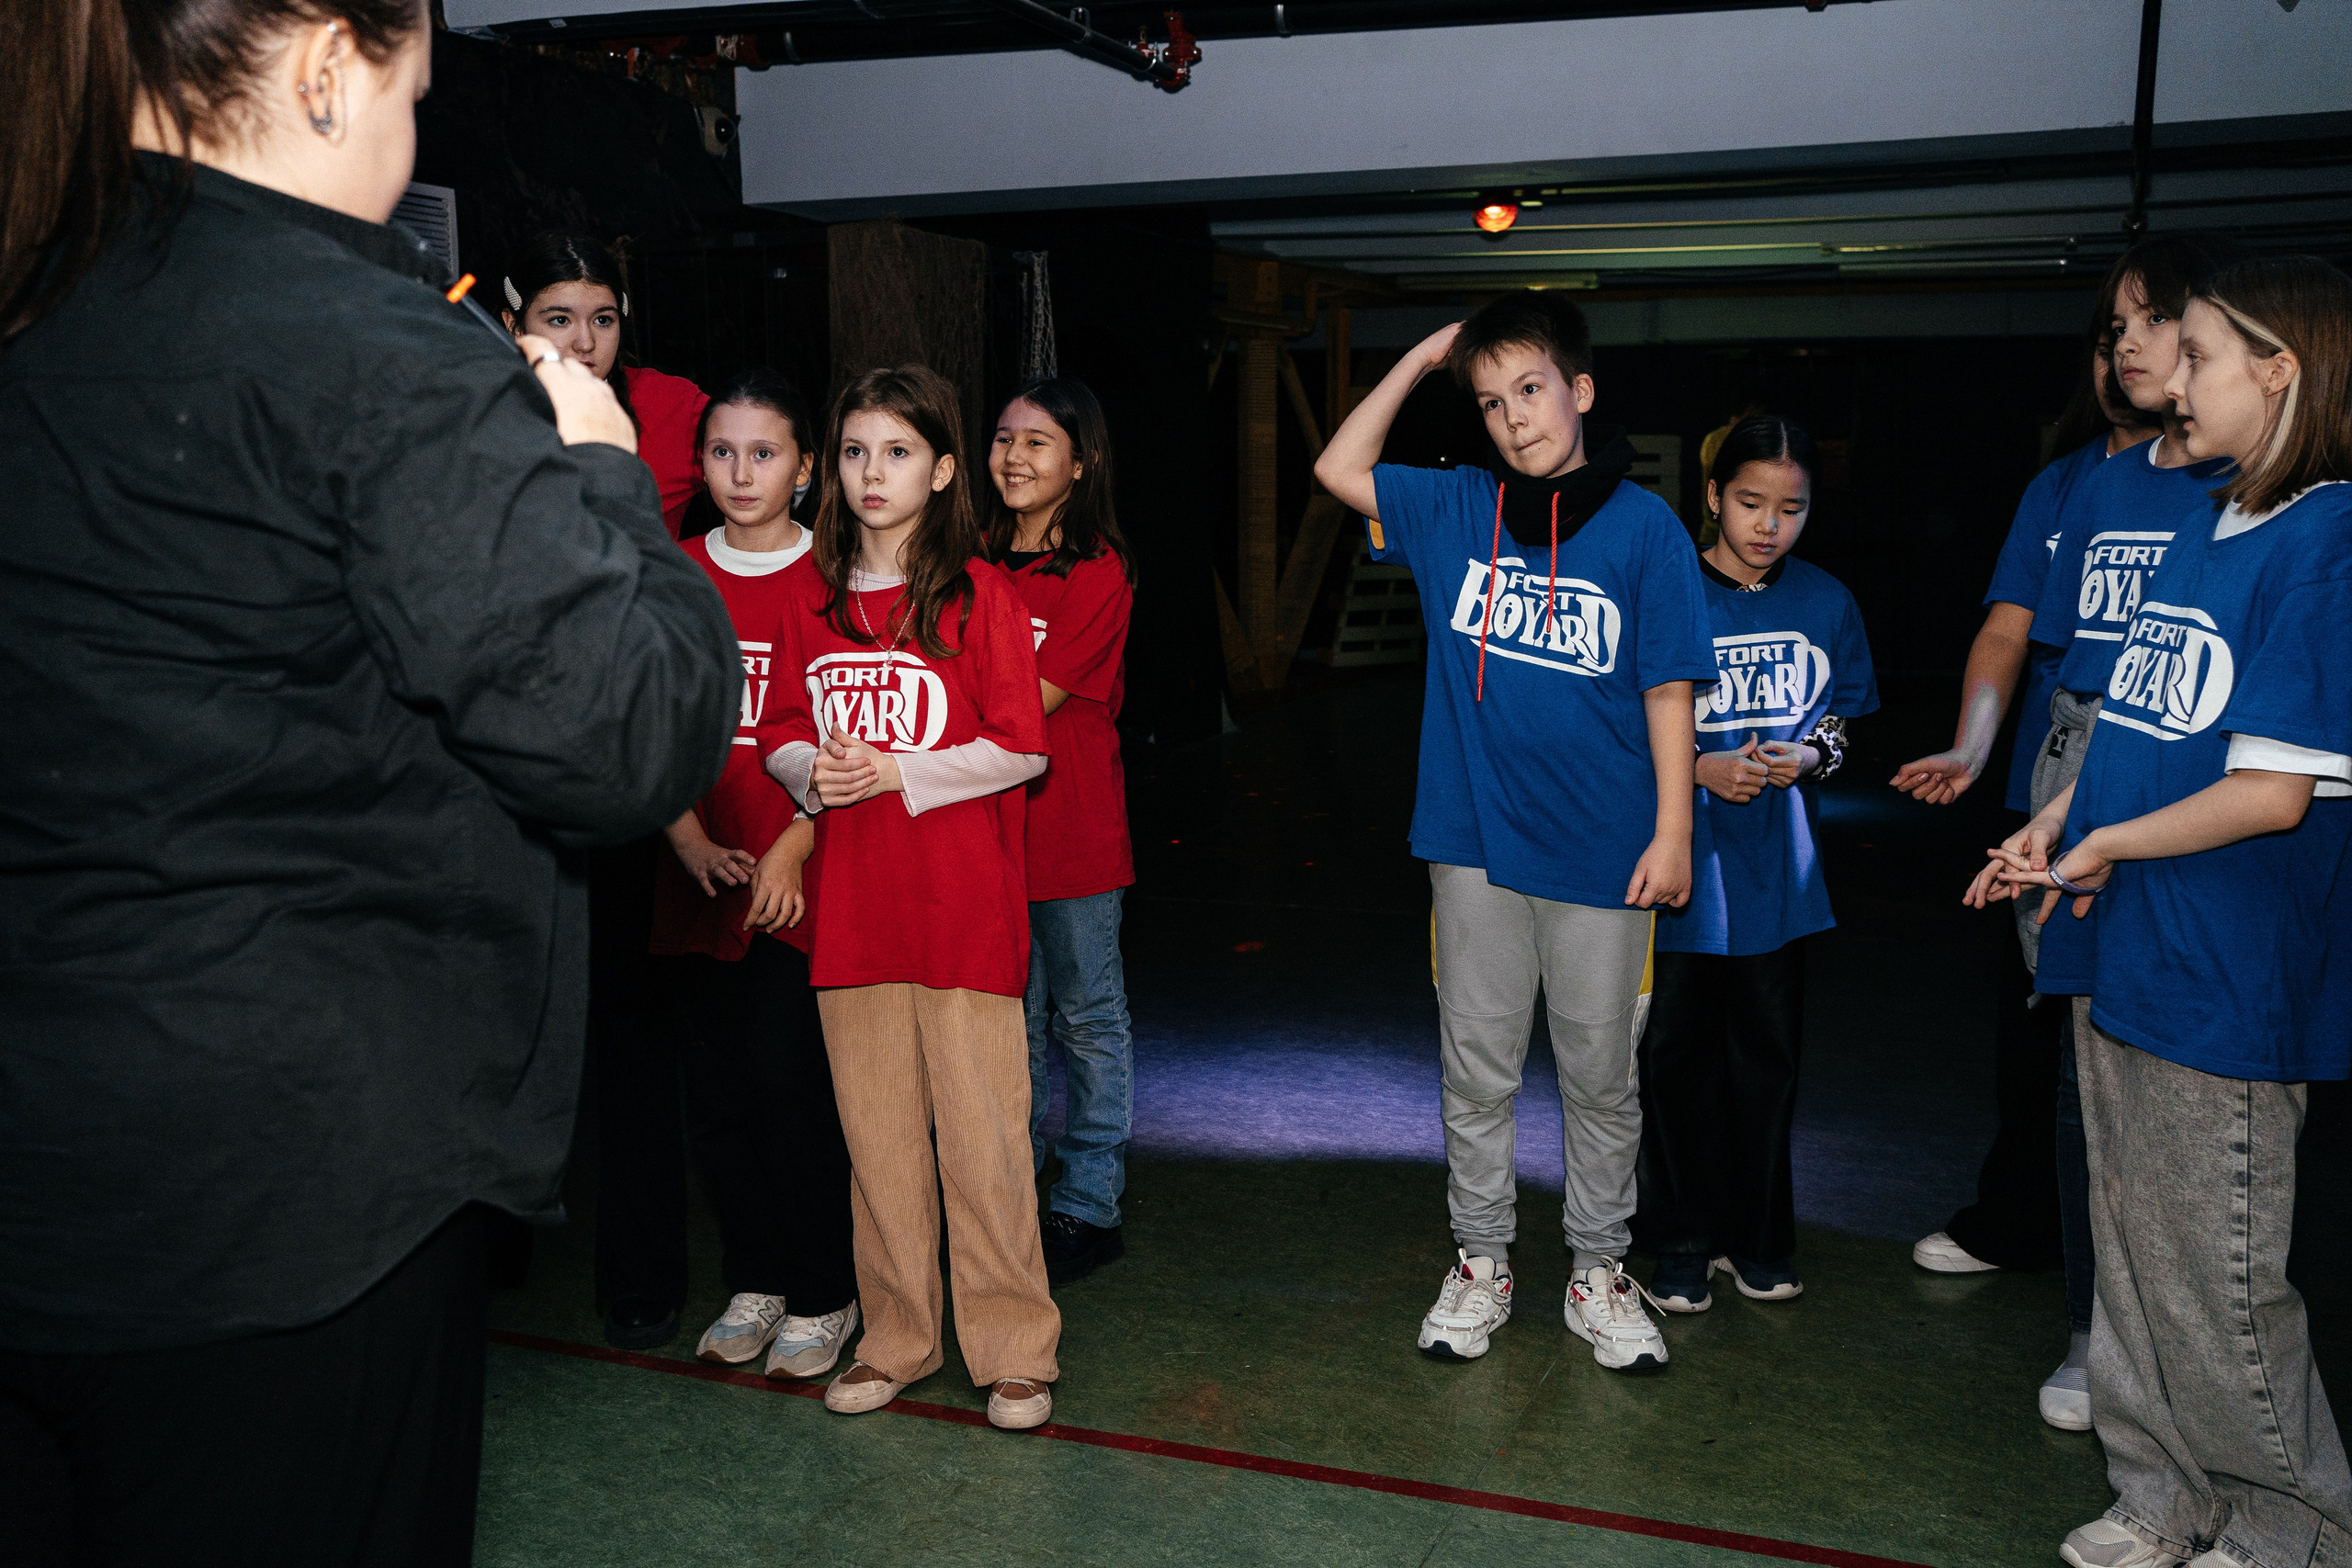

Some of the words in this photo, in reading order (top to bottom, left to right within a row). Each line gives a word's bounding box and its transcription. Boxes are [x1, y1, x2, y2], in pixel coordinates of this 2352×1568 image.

[2092, 546, 2167, 566] FORT
[1450, 558, 1622, 674] BOYARD
[2135, 618, 2187, 647] FORT
[1714, 644, 1786, 667] FORT
[821, 667, 894, 690] FORT
[1694, 641, 1831, 718] OYARD
[2109, 618, 2234, 734] OYARD
